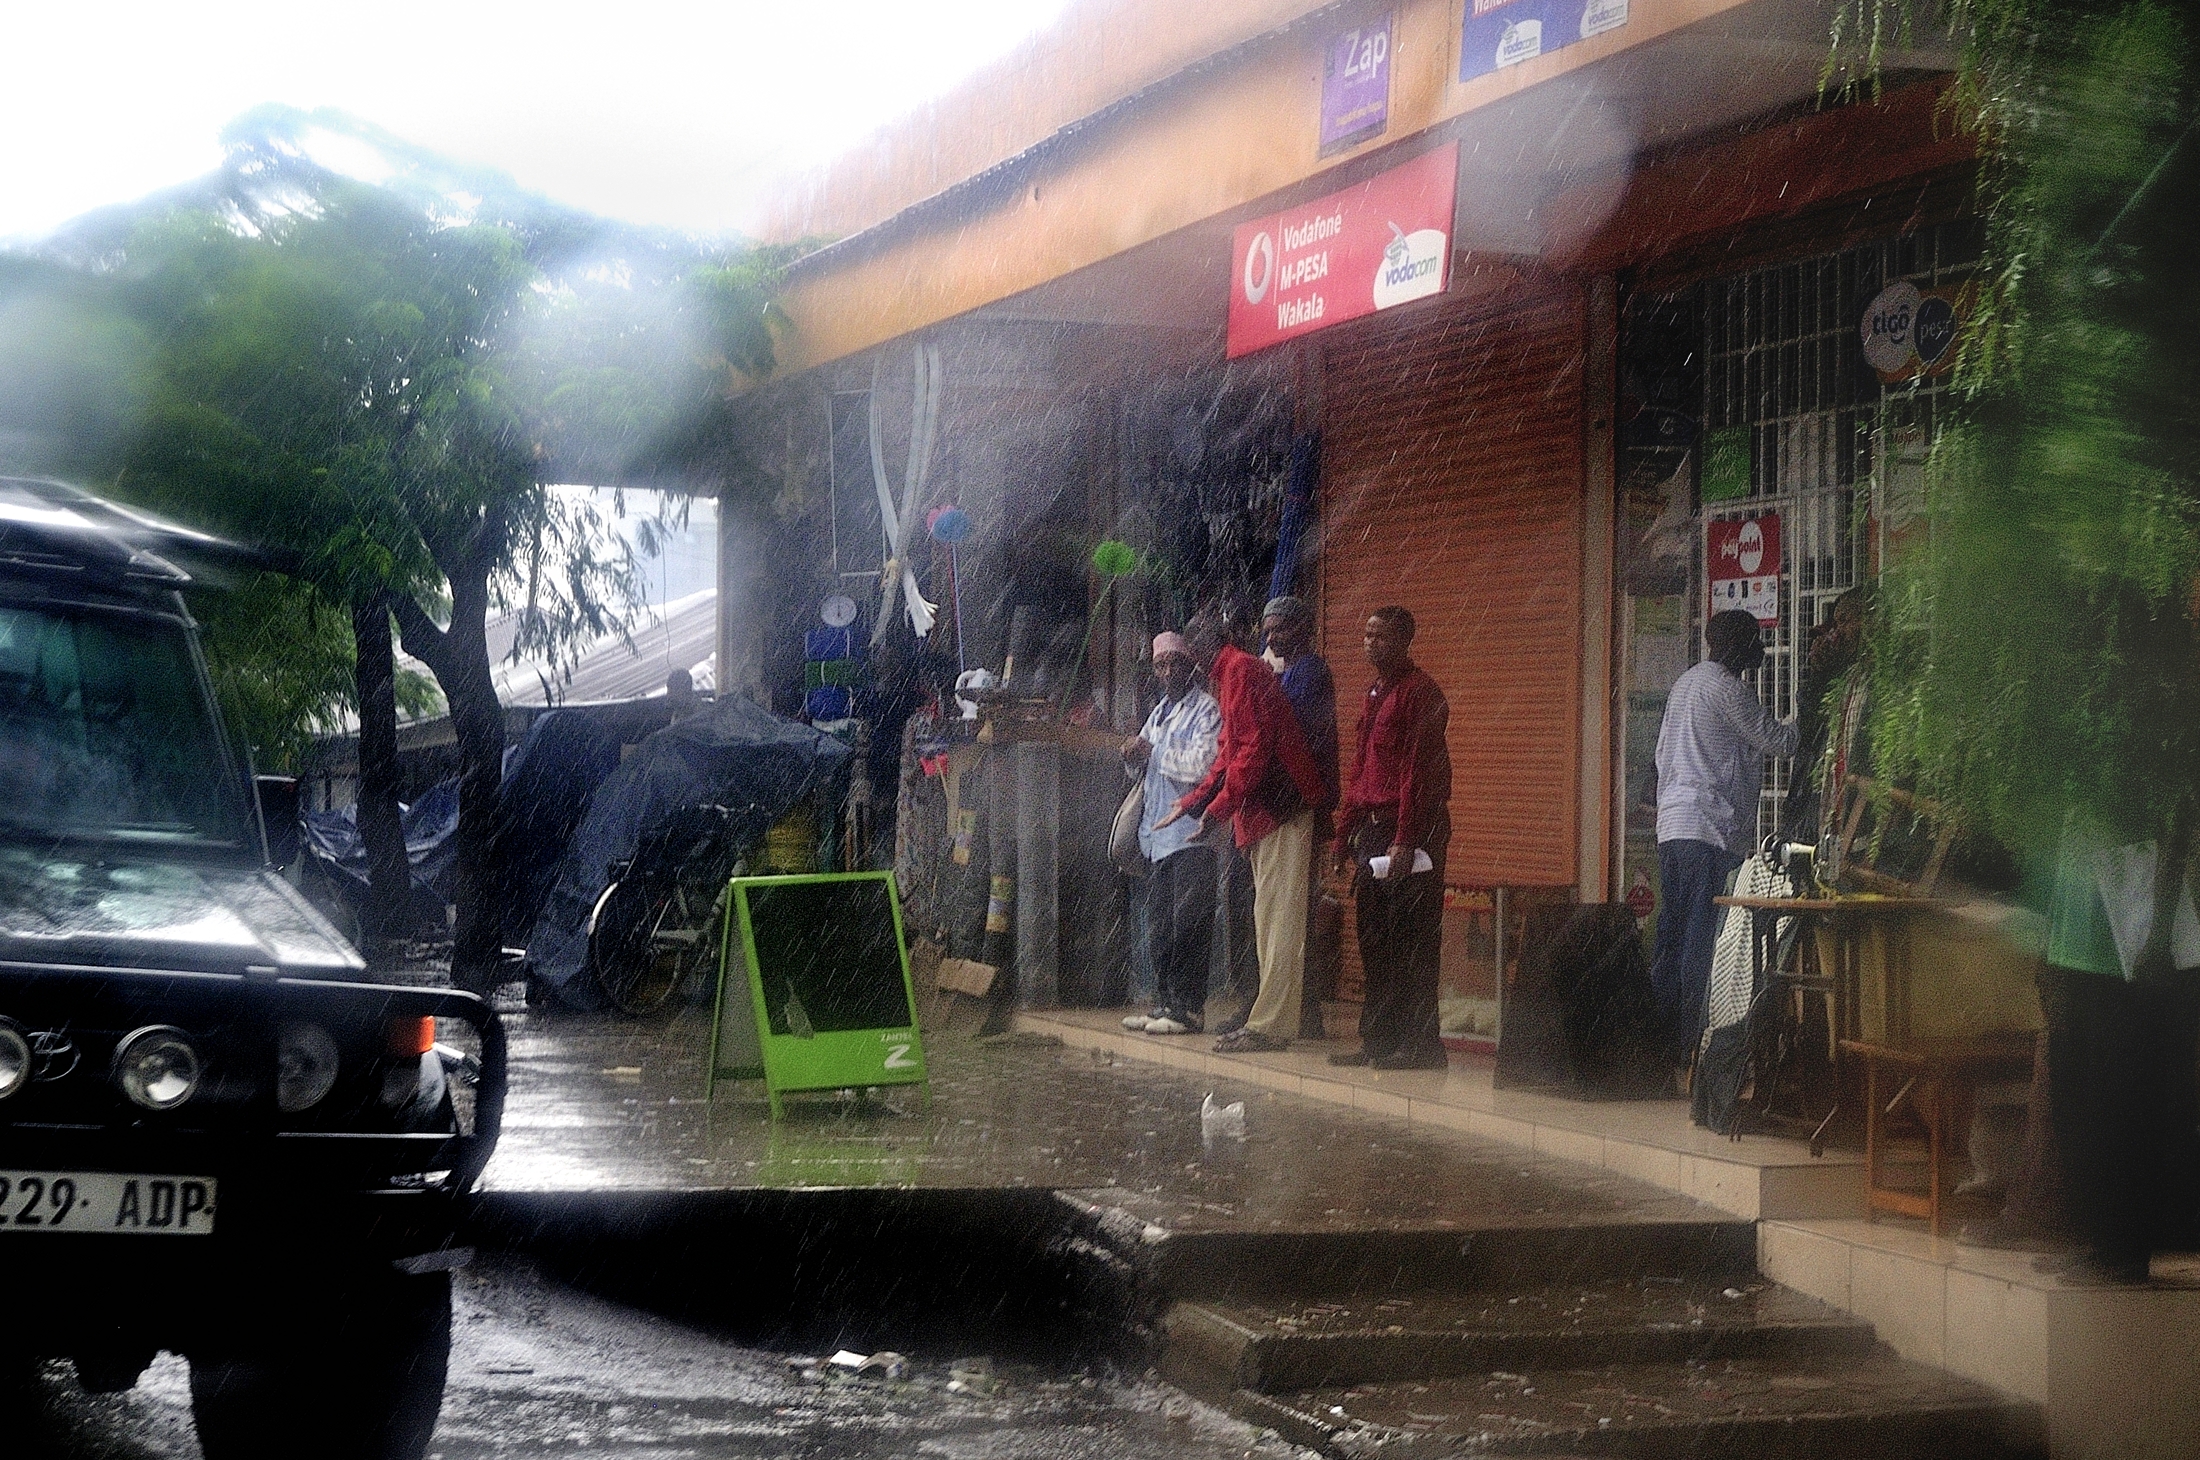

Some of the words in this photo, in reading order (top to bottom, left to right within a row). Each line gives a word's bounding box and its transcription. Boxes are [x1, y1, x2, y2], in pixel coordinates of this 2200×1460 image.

[1344, 29, 1387, 79] Zap
[1284, 213, 1342, 252] Vodafone
[1280, 251, 1328, 291] M-PESA
[1386, 254, 1438, 287] vodacom
[1277, 292, 1324, 330] Wakala
[114, 1178, 207, 1229] ADP
